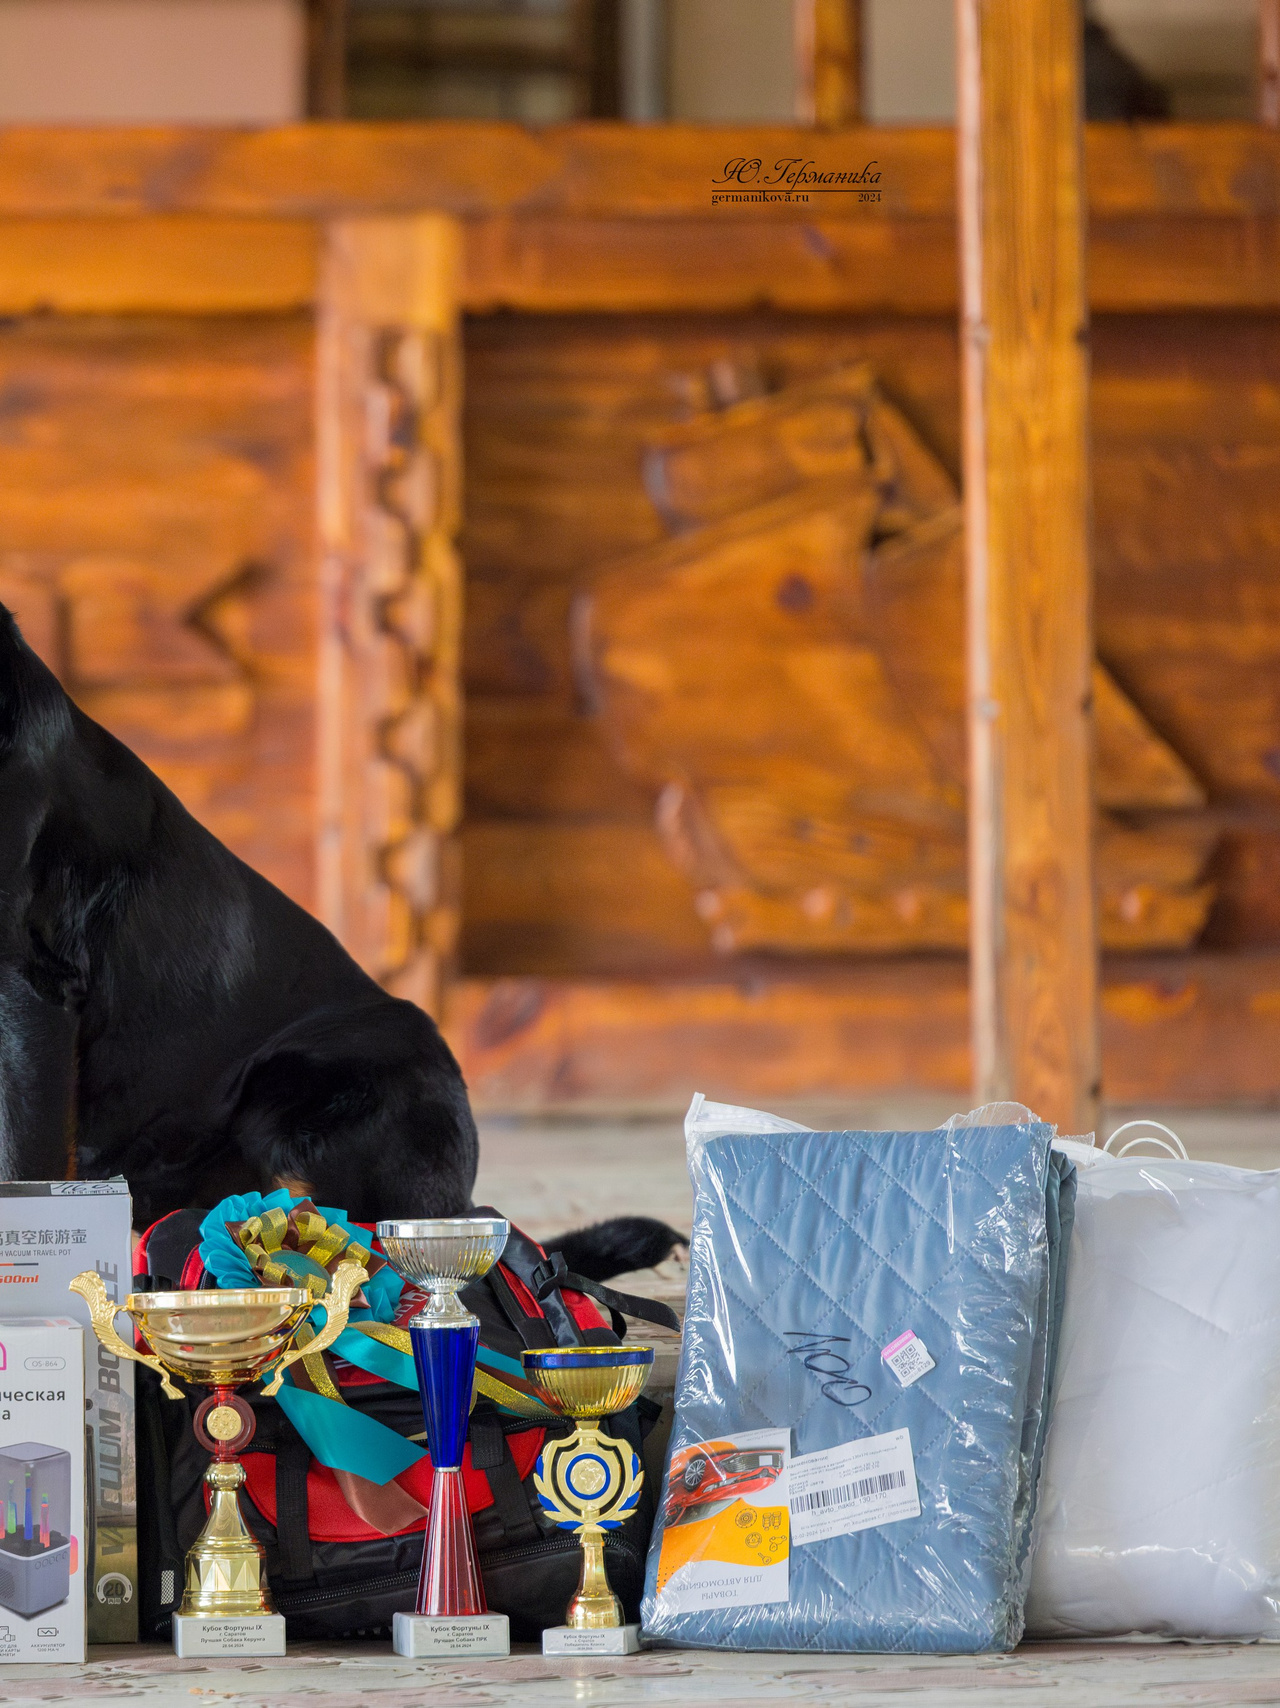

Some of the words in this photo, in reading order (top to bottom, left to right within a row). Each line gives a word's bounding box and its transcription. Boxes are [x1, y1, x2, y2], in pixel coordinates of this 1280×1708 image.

[33, 1249, 57, 1257] TRAVEL
[95, 1259, 120, 1394] BOLE
[744, 1574, 764, 1583] ДЛЯ
[701, 1590, 739, 1600] ТОВАРЫ
[202, 1625, 222, 1633] Кубок
